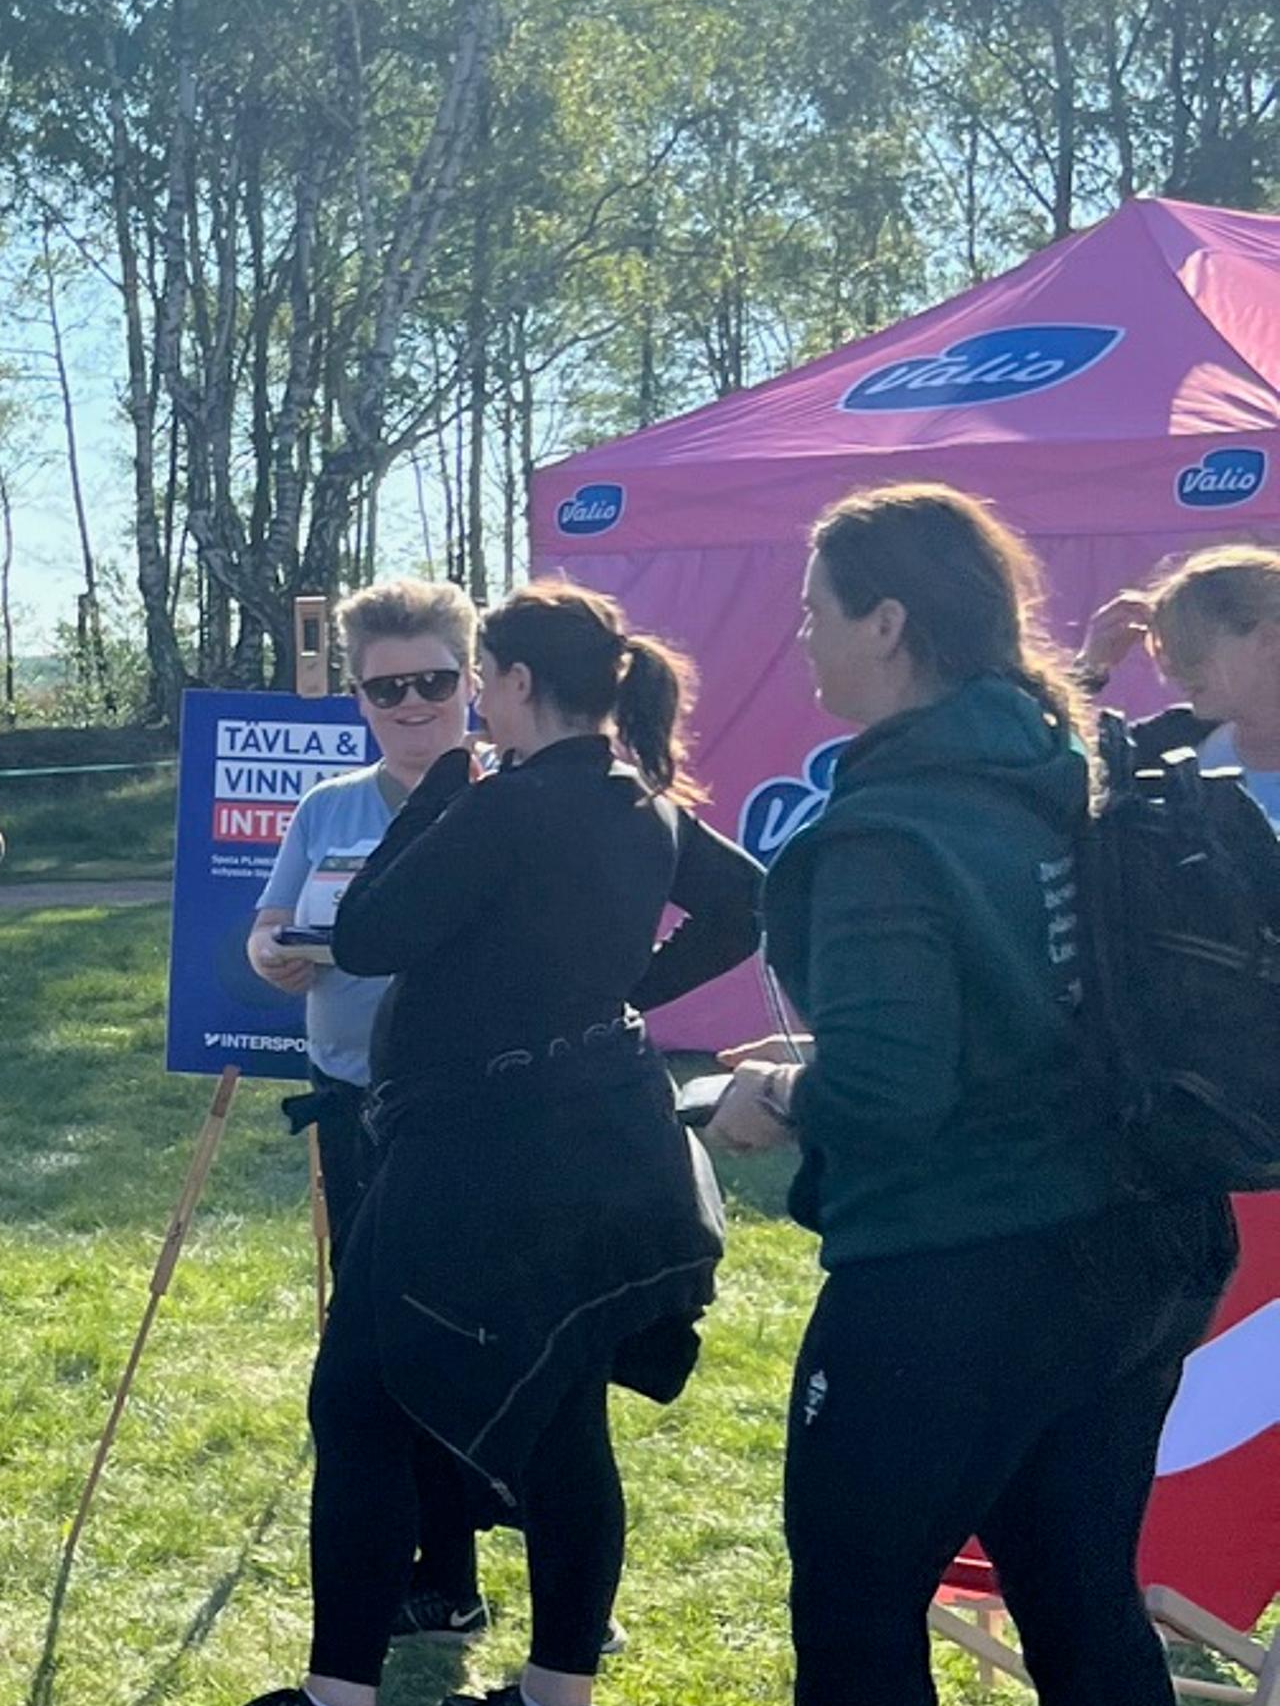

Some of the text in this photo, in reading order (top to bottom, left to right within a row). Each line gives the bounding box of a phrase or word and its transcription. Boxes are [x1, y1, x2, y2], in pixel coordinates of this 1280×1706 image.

[865, 351, 1064, 394] Valio
[1183, 467, 1256, 494] Valio
[562, 499, 616, 524] Valio
[224, 721, 359, 757] TÄVLA &
[224, 767, 302, 795] VINN
